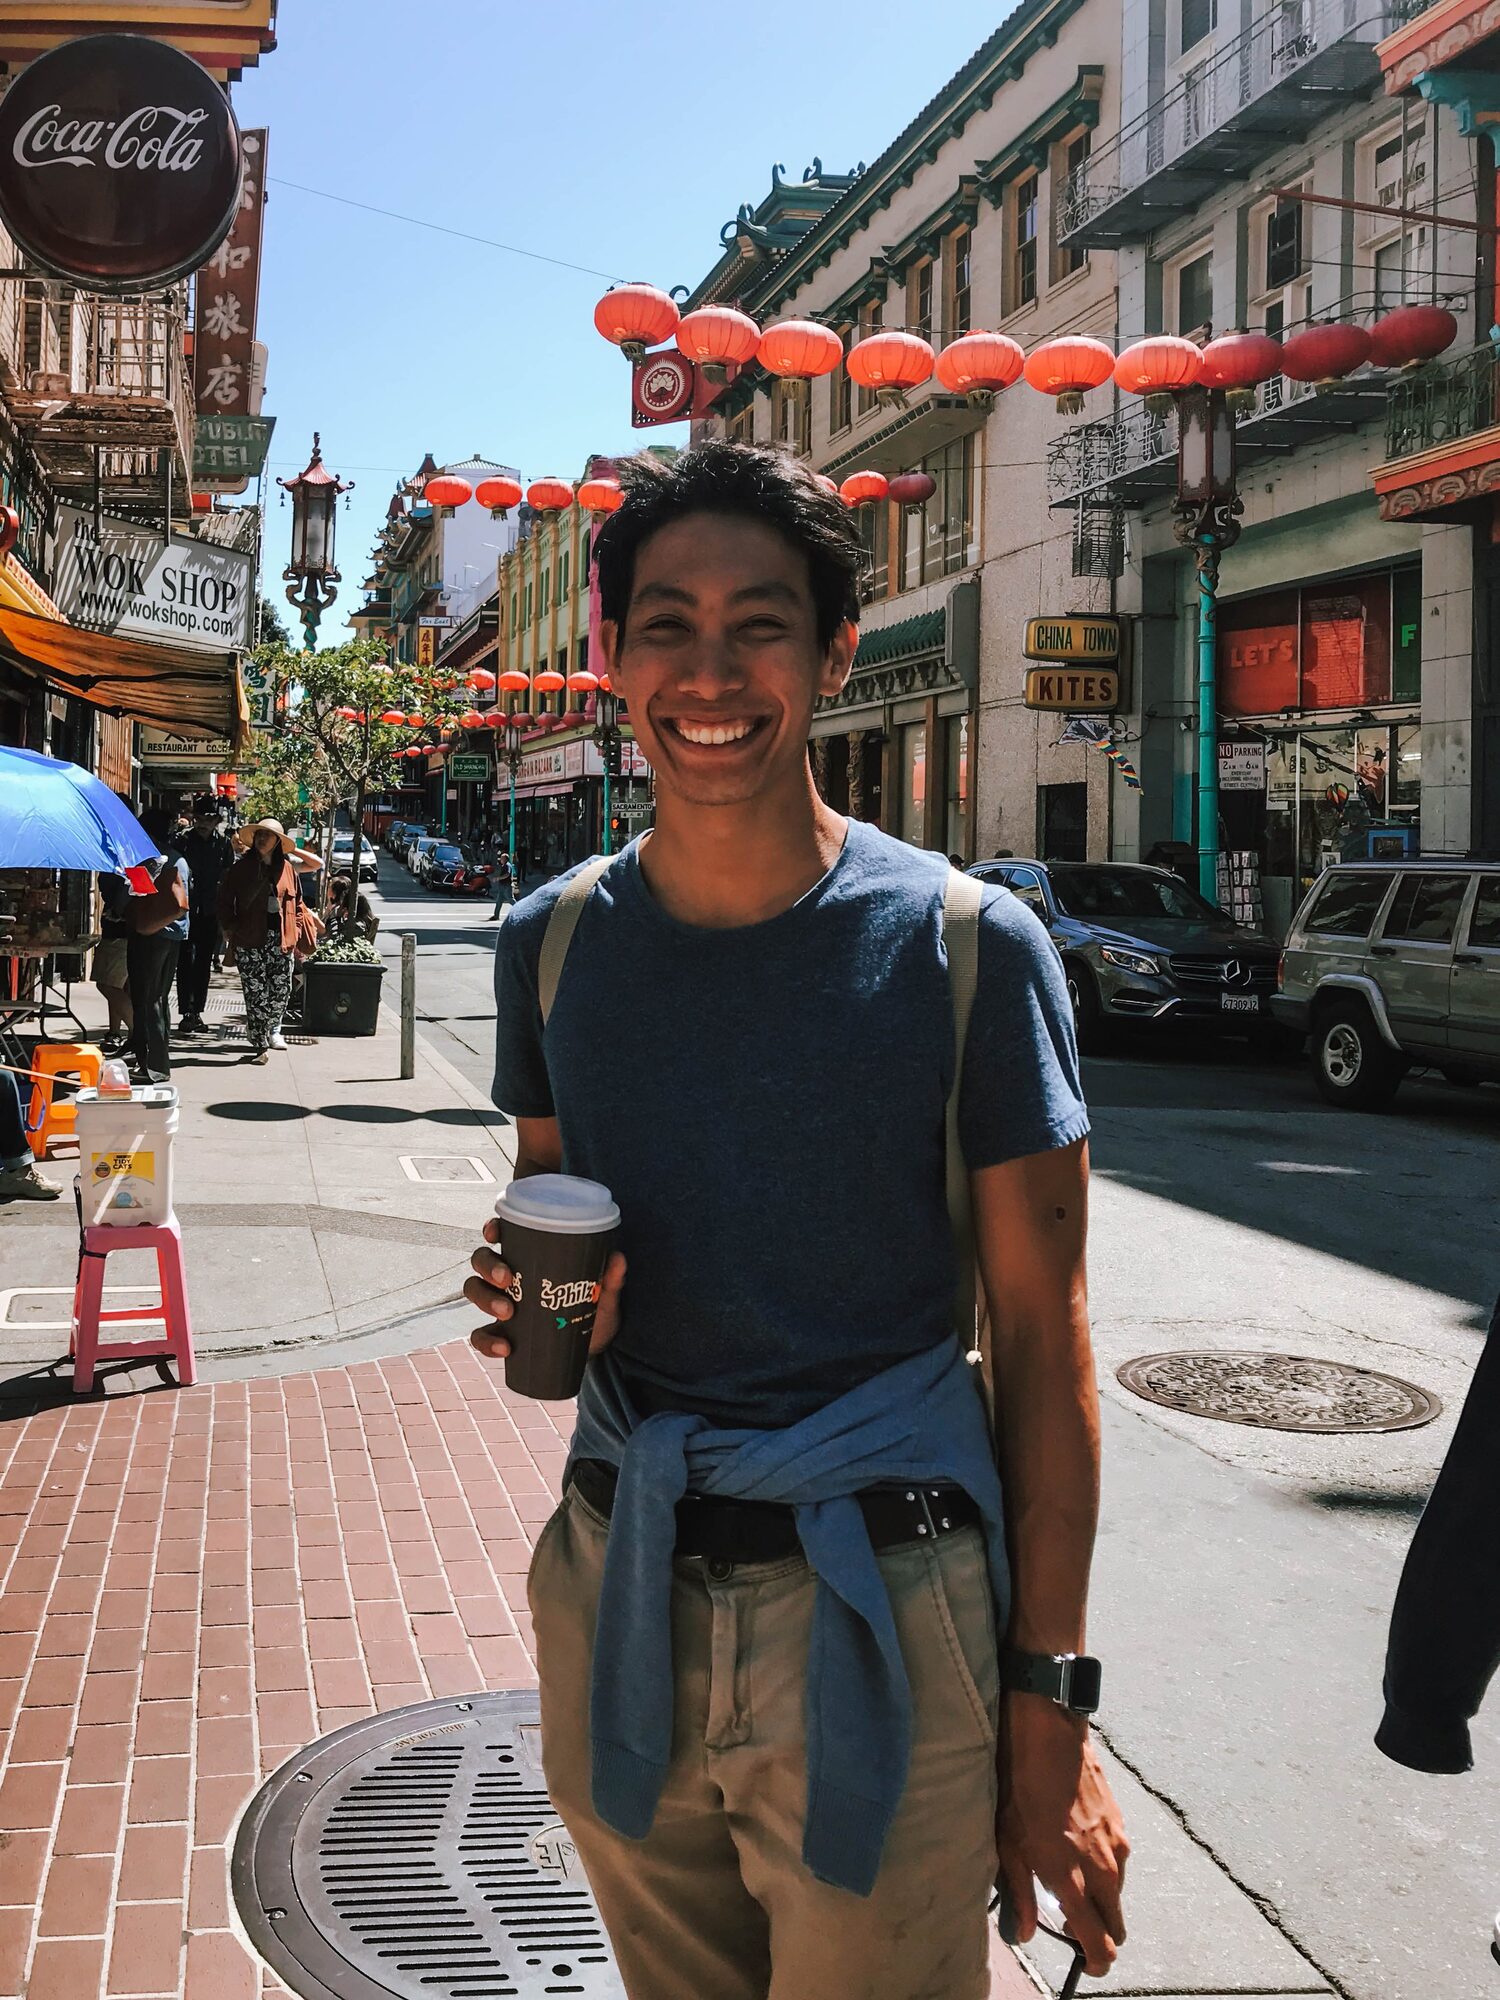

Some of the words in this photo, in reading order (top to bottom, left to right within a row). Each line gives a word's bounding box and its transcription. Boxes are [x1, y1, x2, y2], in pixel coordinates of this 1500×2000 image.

[12, 104, 209, 172] Coca-Cola
[74, 516, 96, 542] the
[74, 545, 147, 597] WOK
[161, 566, 237, 615] SHOP
[78, 590, 234, 638] www.wokshop.com
[1037, 625, 1073, 650] CHINA
[1083, 627, 1117, 652] TOWN
[1230, 639, 1294, 668] LET'S
[1039, 676, 1113, 702] KITES
[147, 743, 198, 752] RESTAURANT
[1219, 745, 1232, 757] NO
[1234, 747, 1263, 757] PARKING
